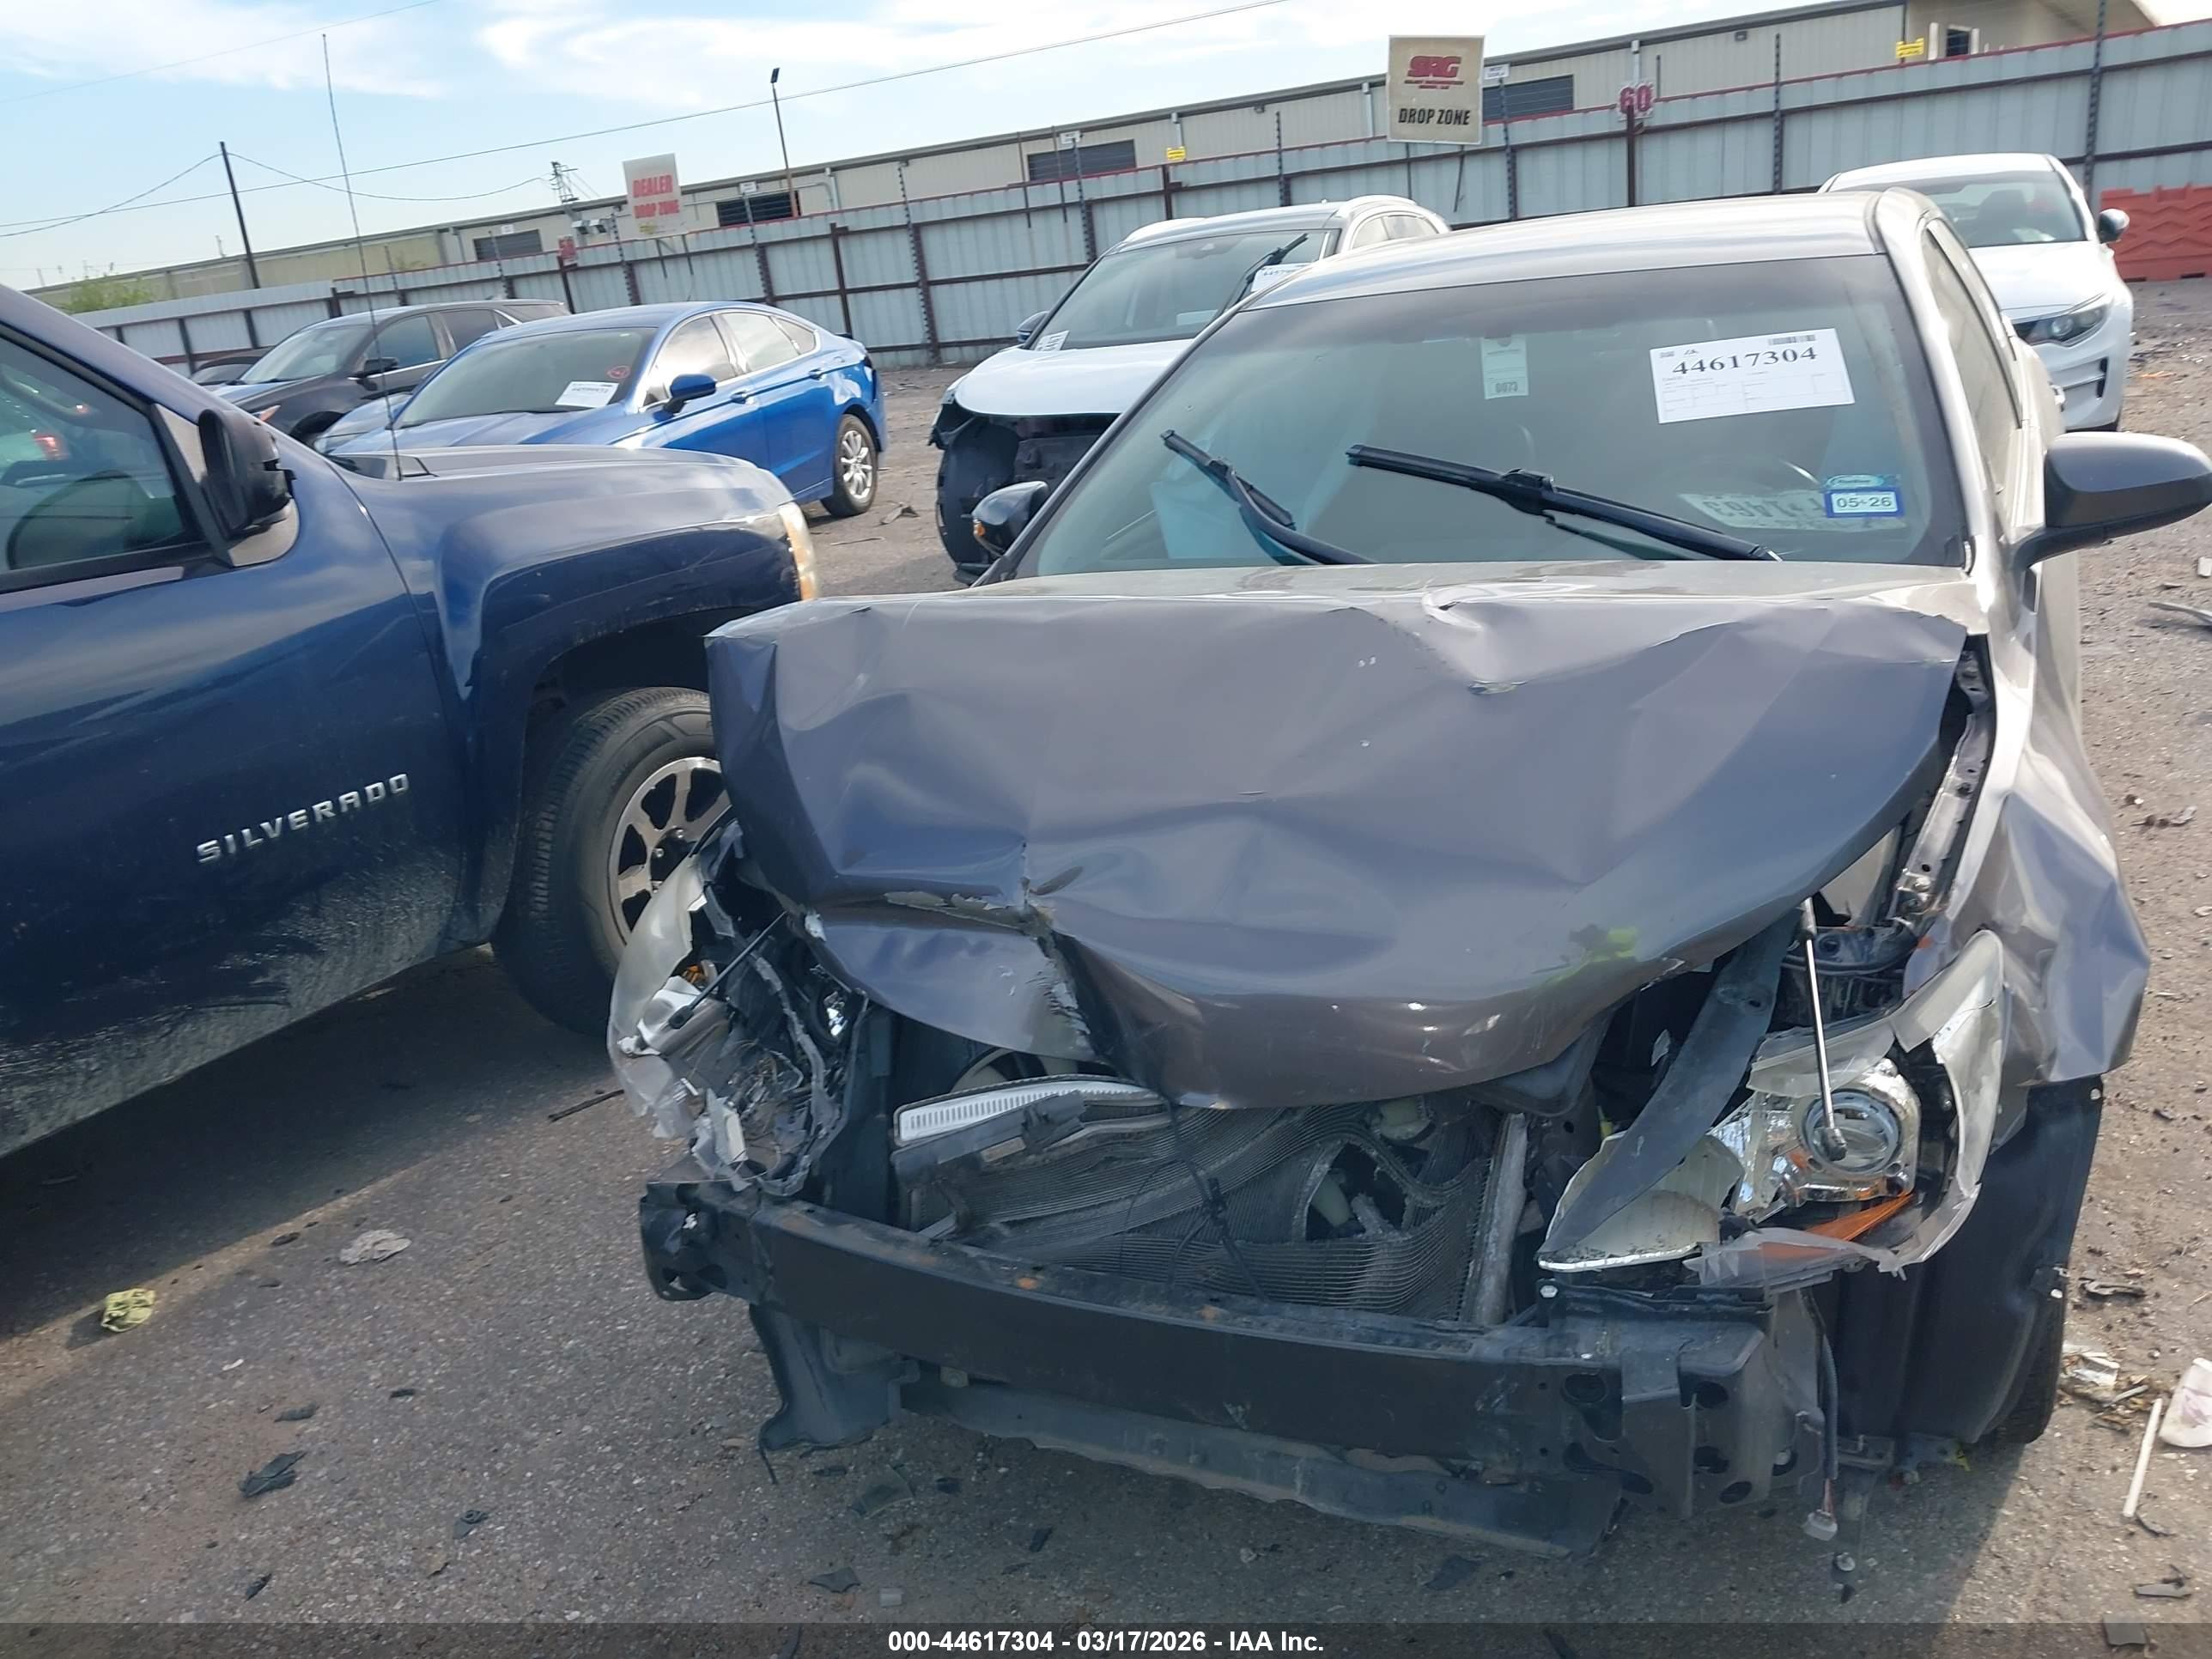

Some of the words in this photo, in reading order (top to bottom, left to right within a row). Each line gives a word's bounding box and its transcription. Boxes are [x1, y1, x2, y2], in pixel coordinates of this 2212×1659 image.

[1620, 85, 1650, 112] 60
[1398, 108, 1435, 124] DROP
[1437, 109, 1471, 125] ZONE
[633, 174, 673, 198] DEALER
[1672, 347, 1817, 374] 44617304
[196, 773, 410, 863] SILVERADO
